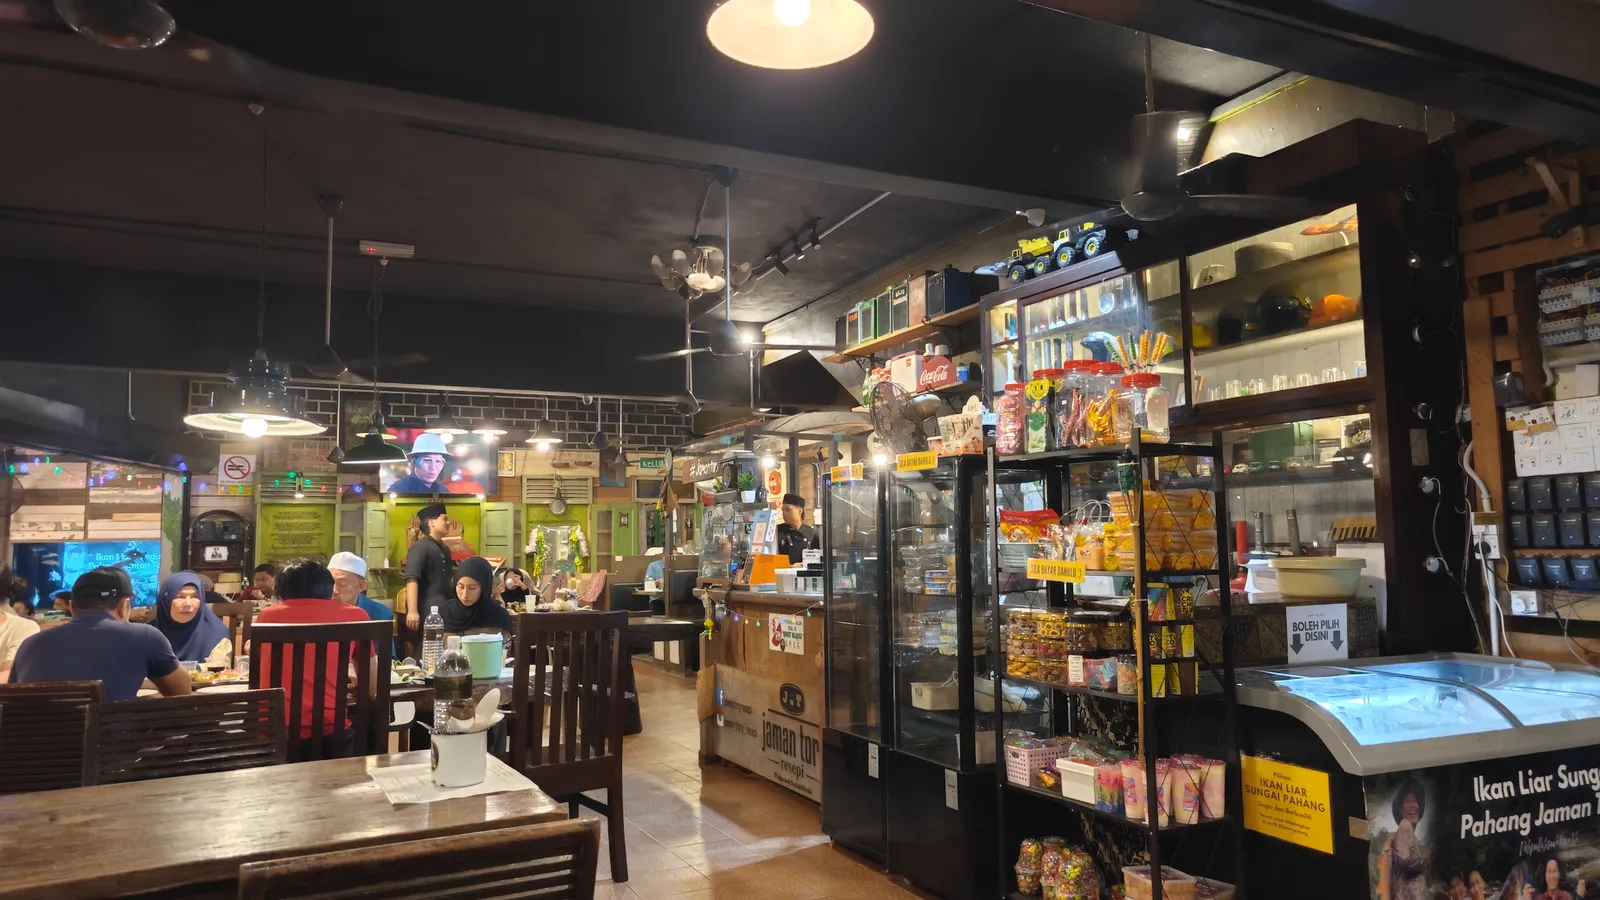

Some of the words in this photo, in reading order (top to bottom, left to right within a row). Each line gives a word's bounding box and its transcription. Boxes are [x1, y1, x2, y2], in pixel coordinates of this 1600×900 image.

[642, 458, 664, 468] KELUA
[96, 552, 114, 561] Ikan
[1041, 564, 1057, 576] BAYAR
[1057, 566, 1076, 577] DAHULU
[1292, 620, 1319, 632] BOLEH
[1321, 619, 1340, 629] PILIH
[1305, 631, 1329, 642] DISINI
[762, 712, 796, 758] jaman
[799, 725, 819, 767] tor
[780, 758, 805, 780] resepi
[1273, 772, 1292, 781] Pilihan
[1260, 777, 1283, 791] IKAN
[1286, 783, 1308, 797] LIAR
[1473, 776, 1515, 802] Ikan
[1518, 769, 1554, 795] Liar
[1558, 764, 1600, 790] Sung
[1245, 784, 1280, 801] SUNGAI
[1283, 794, 1325, 812] PAHANG
[1460, 810, 1531, 839] Pahang
[1534, 802, 1591, 826] Jaman
